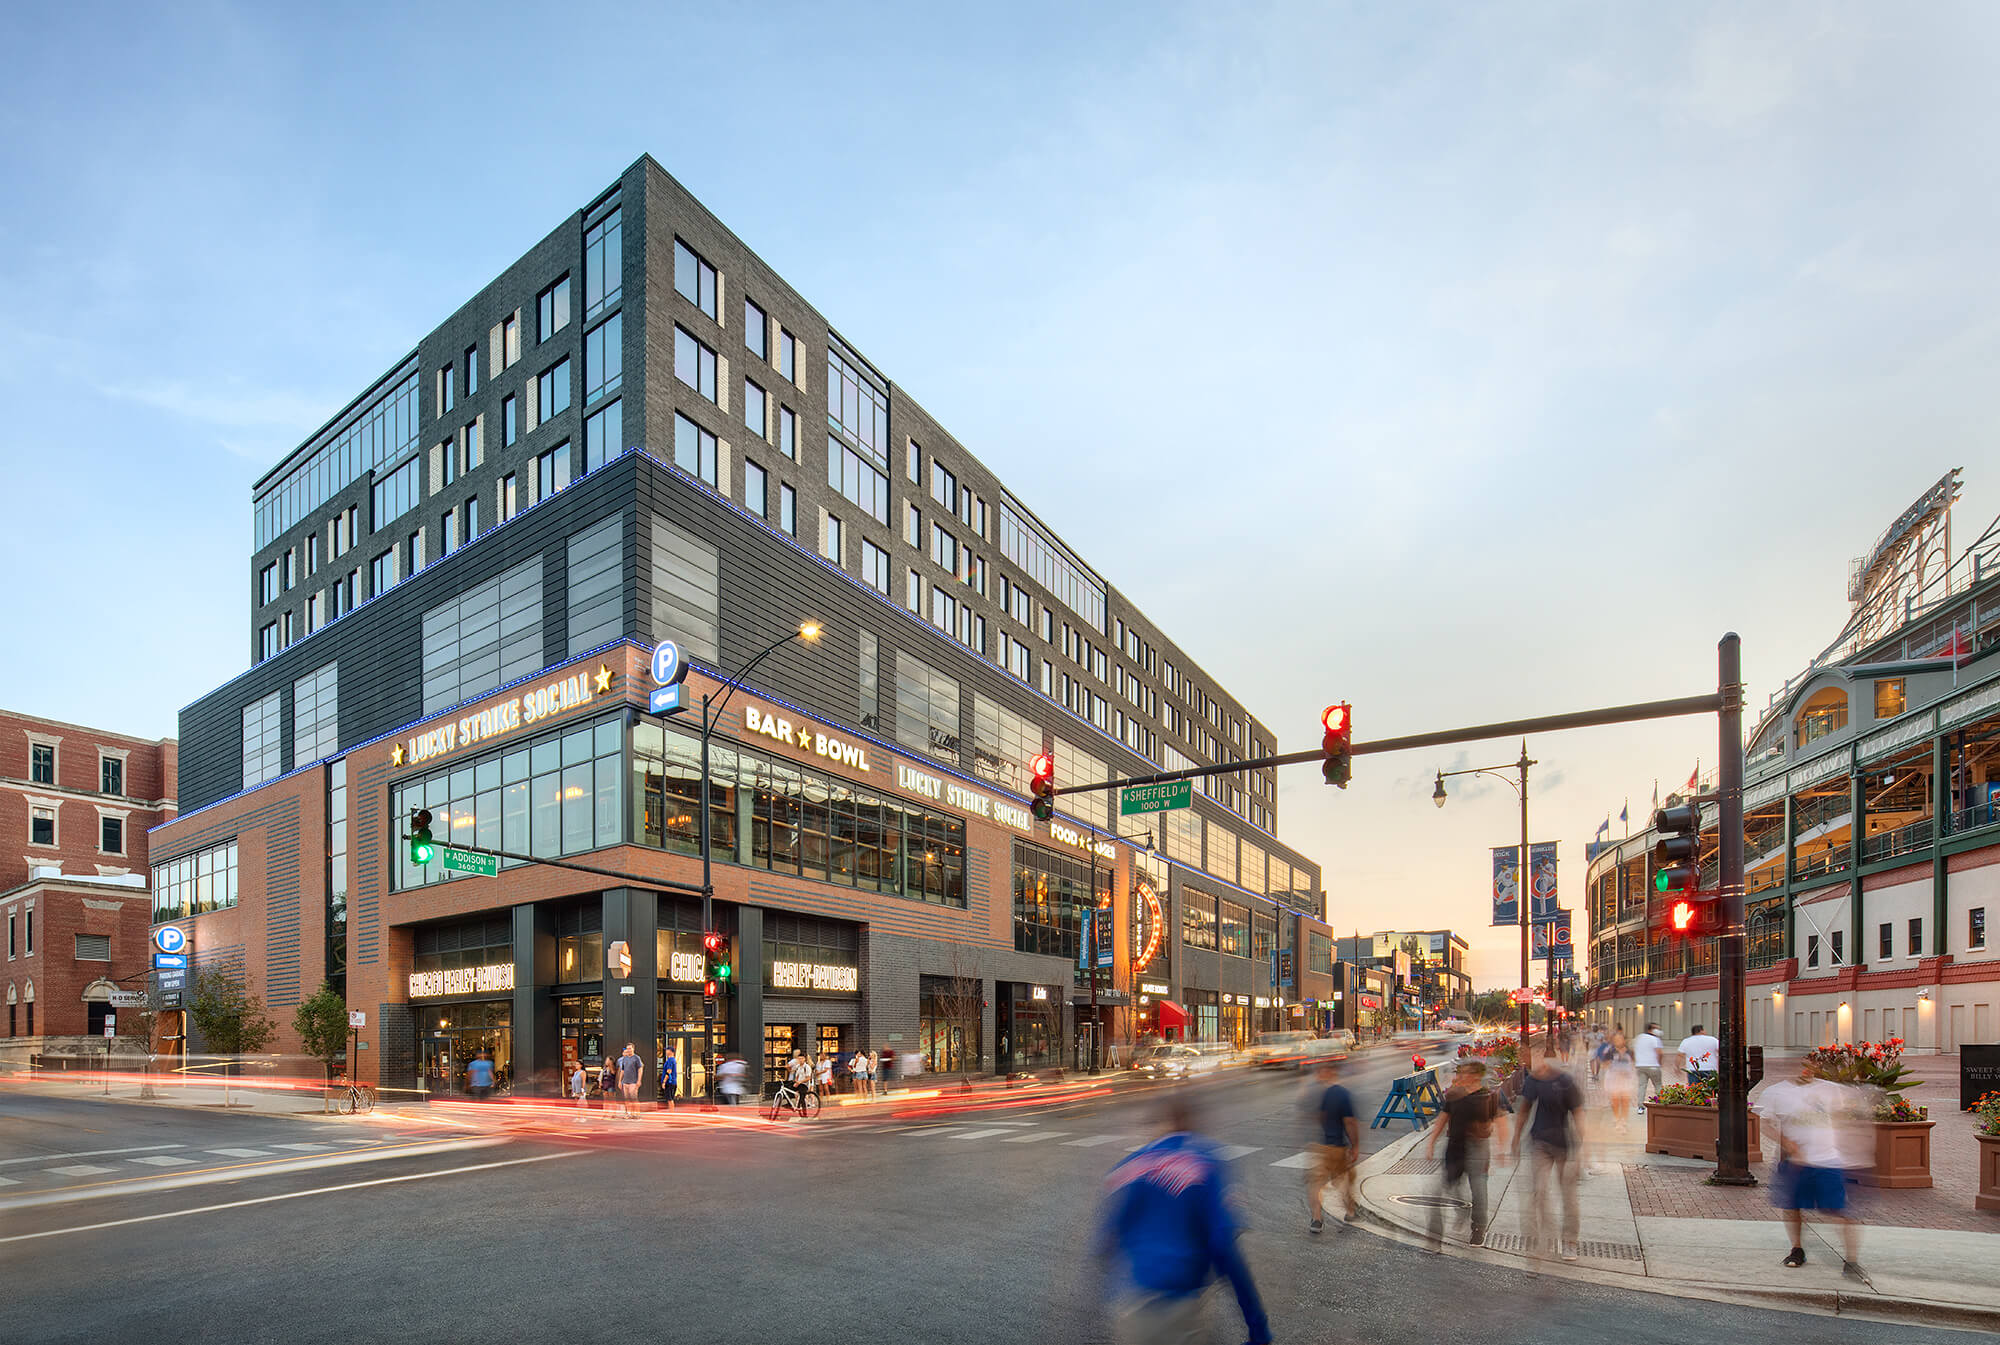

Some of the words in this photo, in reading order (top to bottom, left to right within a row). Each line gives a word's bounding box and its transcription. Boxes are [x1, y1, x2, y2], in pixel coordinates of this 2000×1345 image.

[658, 647, 674, 679] P
[408, 722, 457, 764] LUCKY
[459, 697, 520, 746] STRIKE
[523, 671, 593, 724] SOCIAL
[746, 706, 794, 745] BAR
[816, 732, 870, 771] BOWL
[898, 765, 942, 800] LUCKY
[946, 783, 990, 817] STRIKE
[993, 801, 1031, 832] SOCIAL
[1130, 786, 1178, 802] SHEFFIELD
[1180, 785, 1189, 794] AV
[1141, 800, 1160, 811] 1000
[1164, 799, 1171, 808] W
[1050, 823, 1078, 846] FOOD
[452, 852, 487, 866] ADDISON
[457, 862, 475, 872] 3600
[163, 929, 180, 949] P
[409, 973, 443, 998] CHICAGO
[444, 963, 515, 995] HARLEY-DAVIDSO
[773, 961, 858, 991] HARLEY-DAVIDSON
